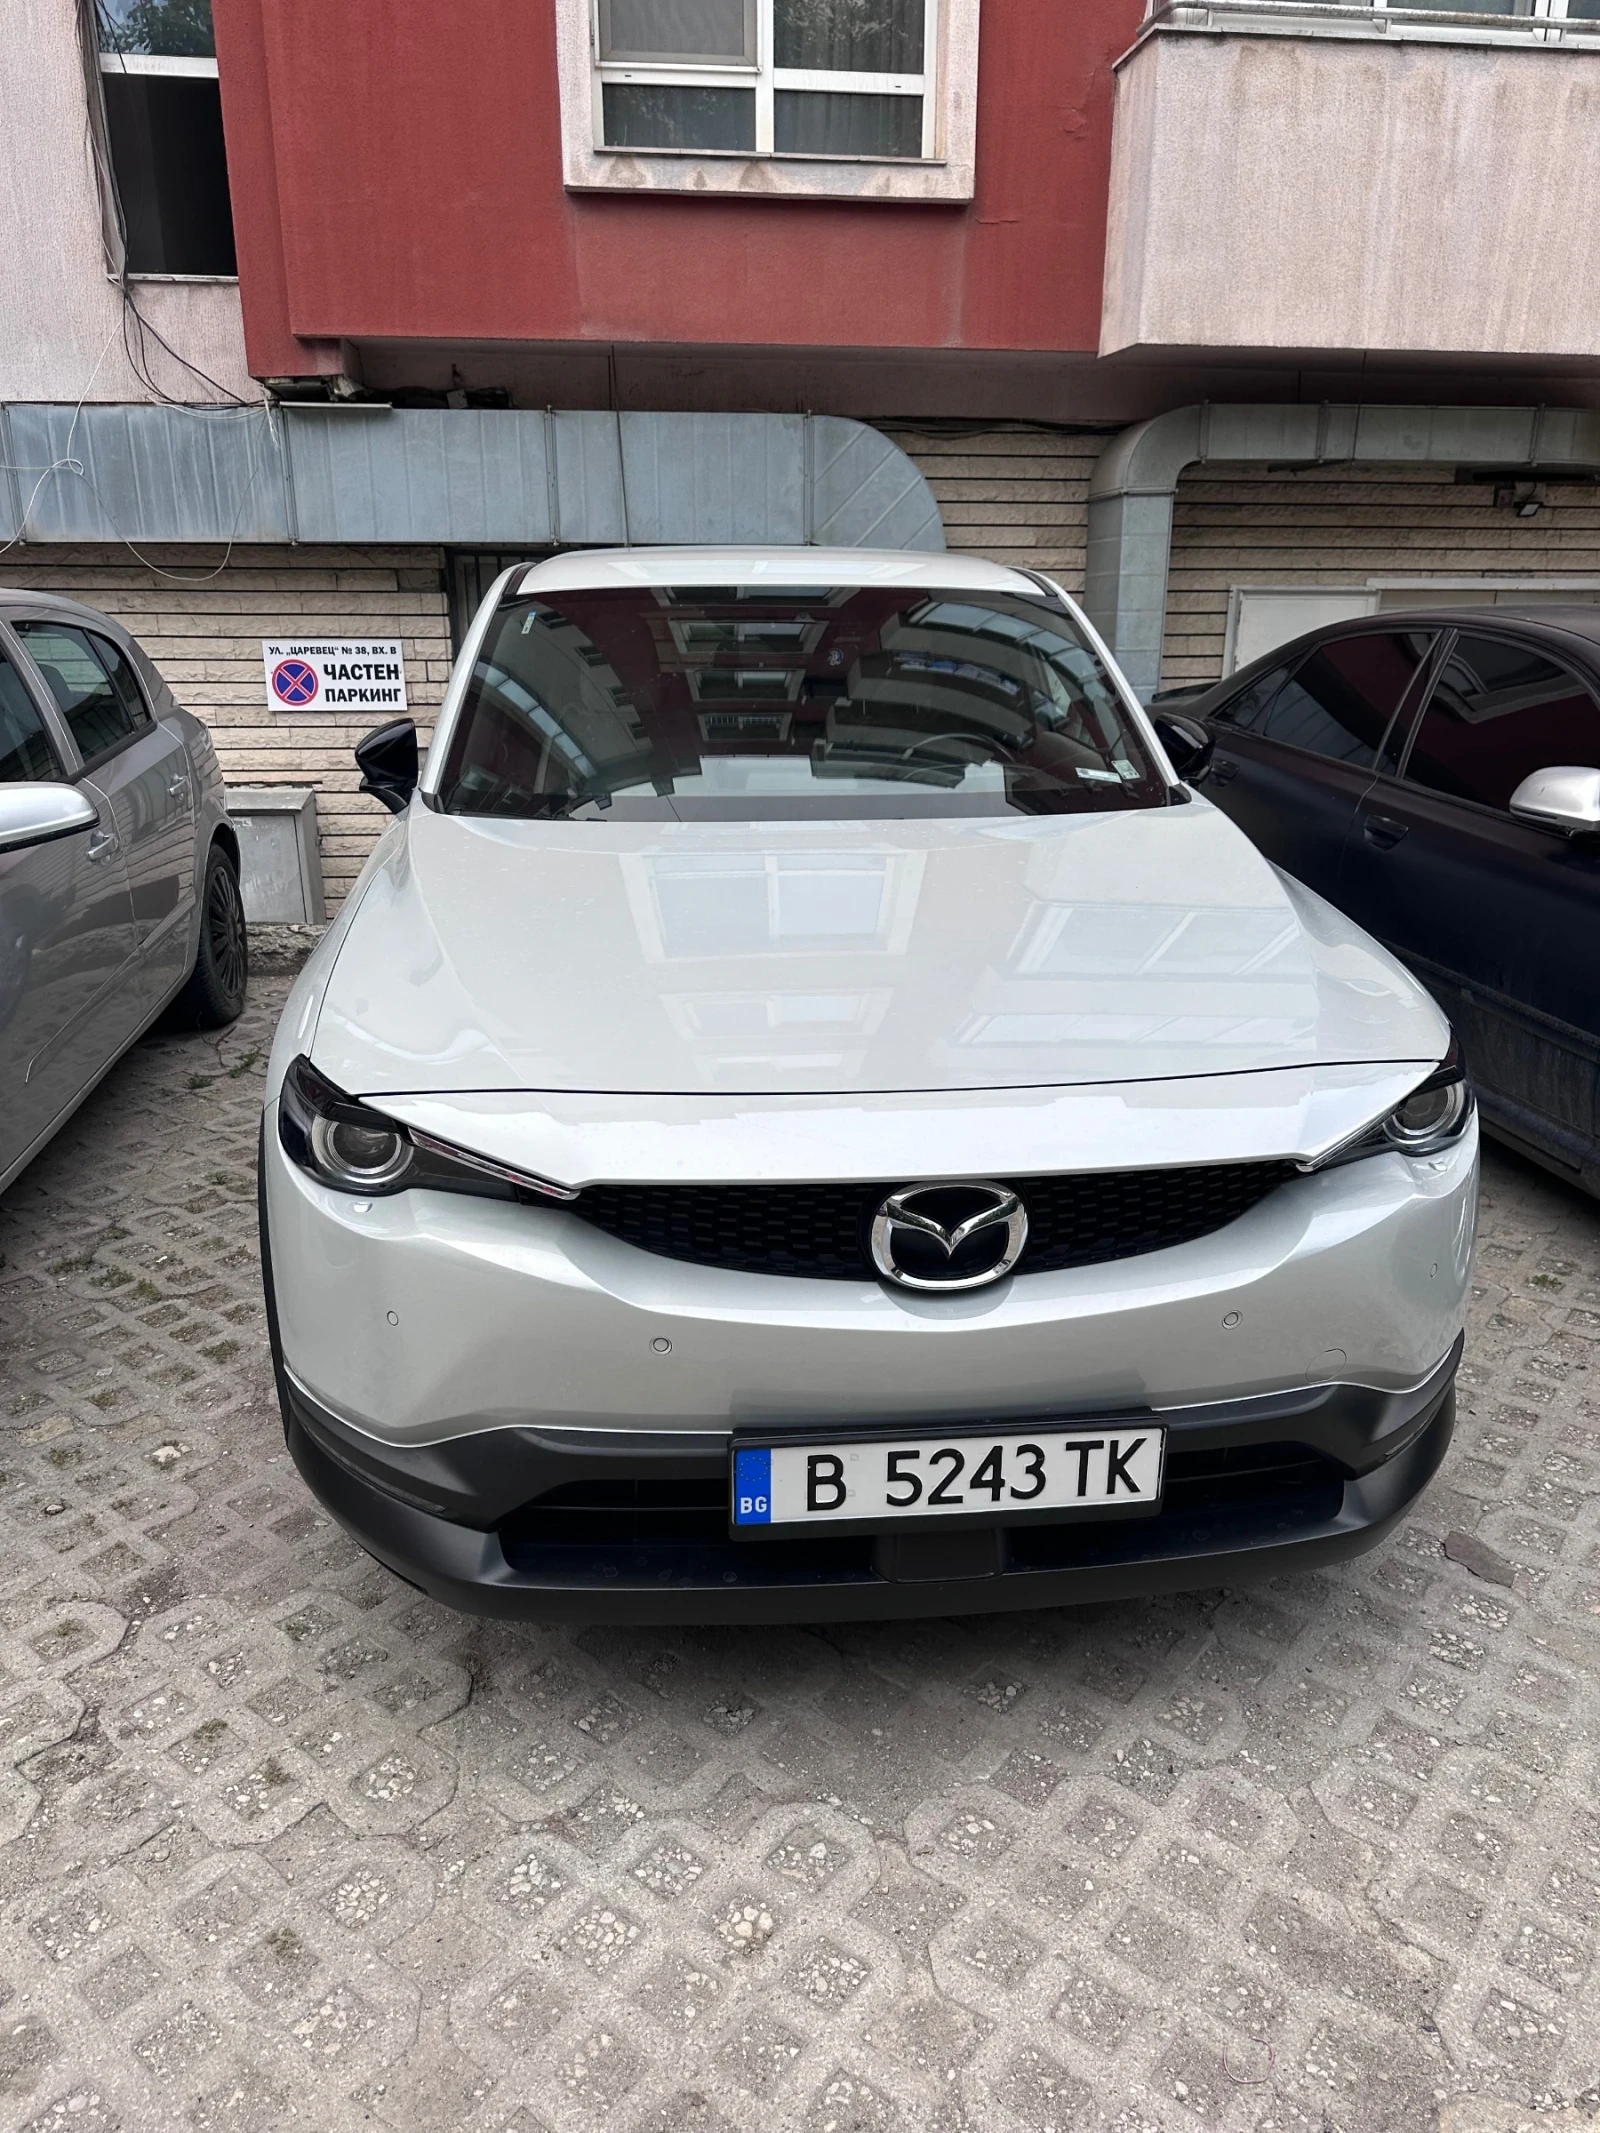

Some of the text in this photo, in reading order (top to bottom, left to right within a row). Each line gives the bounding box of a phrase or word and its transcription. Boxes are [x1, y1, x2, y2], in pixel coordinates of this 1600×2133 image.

[268, 646, 284, 655] УЛ.
[341, 646, 353, 655] №
[355, 646, 370, 656] 38,
[372, 646, 388, 655] ВХ.
[390, 646, 397, 655] В
[323, 664, 400, 680] ЧАСТЕН
[325, 688, 401, 702] ПАРКИНГ
[806, 1437, 1147, 1512] B 5243 TK
[740, 1496, 768, 1514] BG
